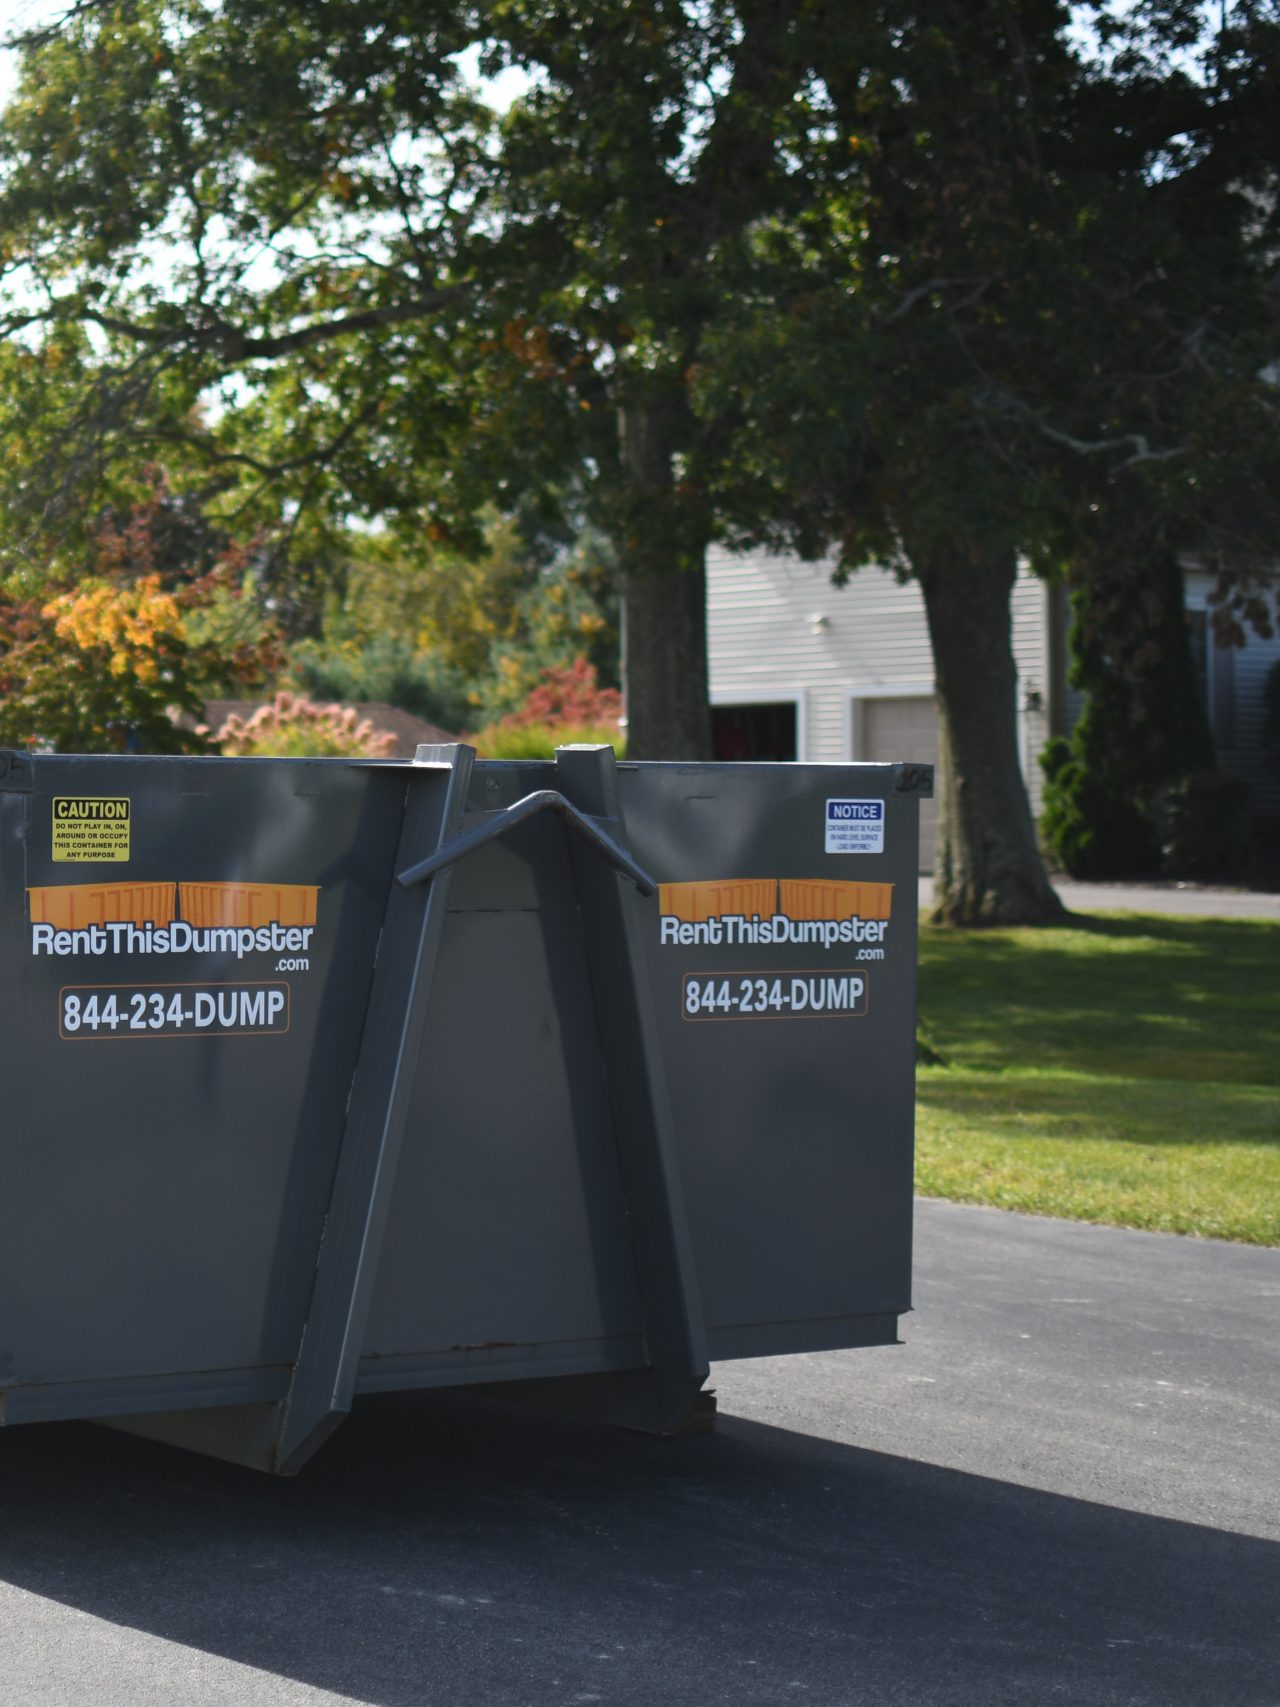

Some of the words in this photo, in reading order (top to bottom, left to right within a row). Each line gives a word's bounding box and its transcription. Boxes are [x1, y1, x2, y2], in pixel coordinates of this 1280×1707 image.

[57, 801, 127, 818] CAUTION
[833, 805, 878, 818] NOTICE
[32, 922, 314, 959] RentThisDumpster
[660, 915, 889, 950] RentThisDumpster
[275, 957, 310, 971] .com
[855, 949, 885, 960] .com
[685, 977, 864, 1014] 844-234-DUMP
[63, 990, 285, 1031] 844-234-DUMP
